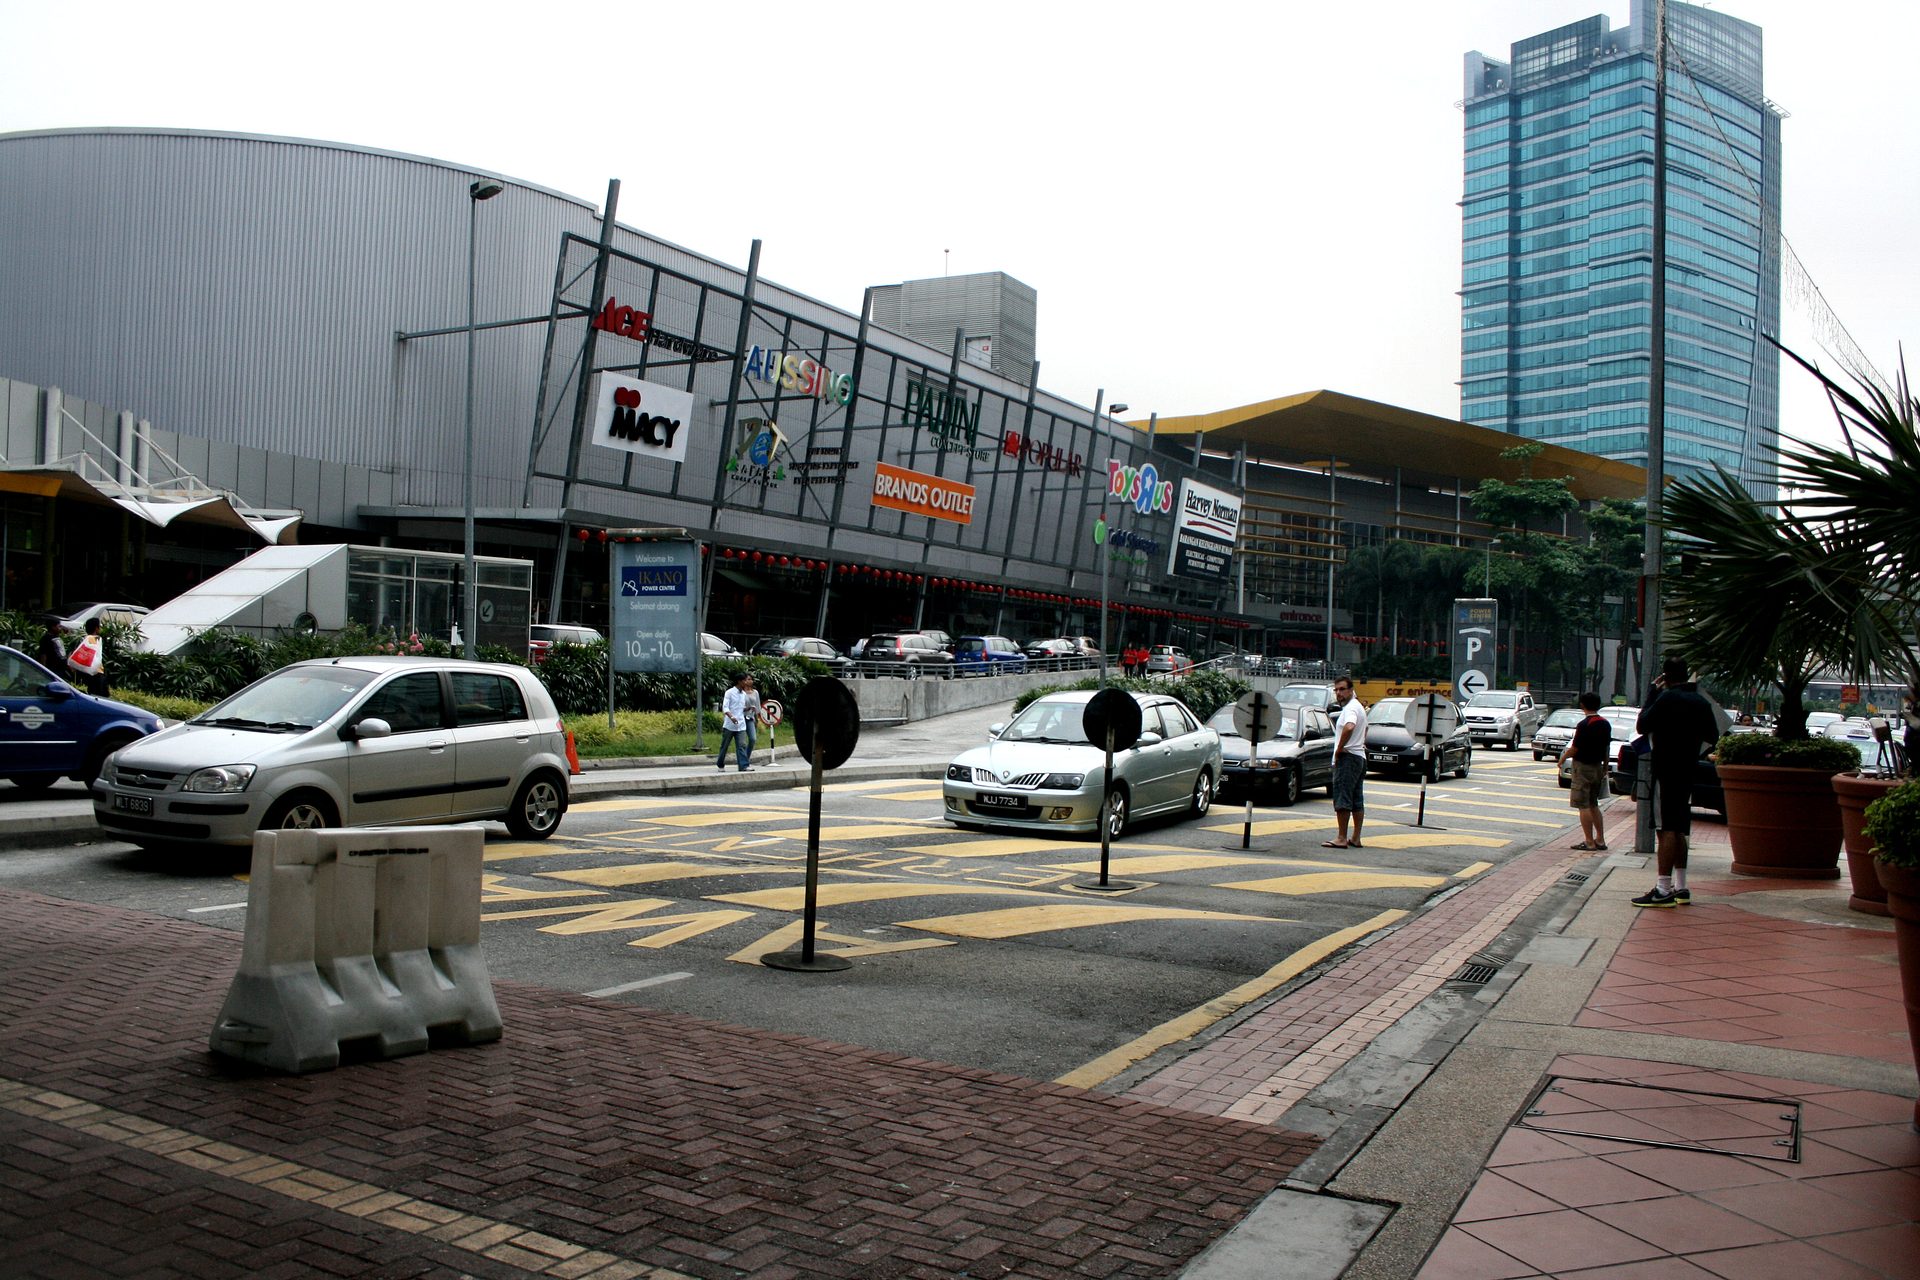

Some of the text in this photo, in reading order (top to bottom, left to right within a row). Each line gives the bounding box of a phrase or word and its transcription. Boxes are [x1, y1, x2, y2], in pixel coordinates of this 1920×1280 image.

[592, 296, 653, 342] ACE
[743, 345, 855, 406] AUSSINO
[902, 381, 981, 446] PADINI
[609, 407, 681, 449] MACY
[874, 473, 976, 516] BRANDS OUTLET
[1185, 489, 1238, 523] Harvey Norman
[635, 554, 674, 563] Welcome to
[639, 571, 683, 585] IKANO
[630, 601, 680, 612] Selamat datang
[1280, 610, 1323, 623] entrance
[636, 630, 653, 640] Open
[1466, 637, 1482, 661] P
[1386, 686, 1406, 697] car
[131, 798, 149, 812] 6839
[983, 795, 1018, 806] WJJ 7734
